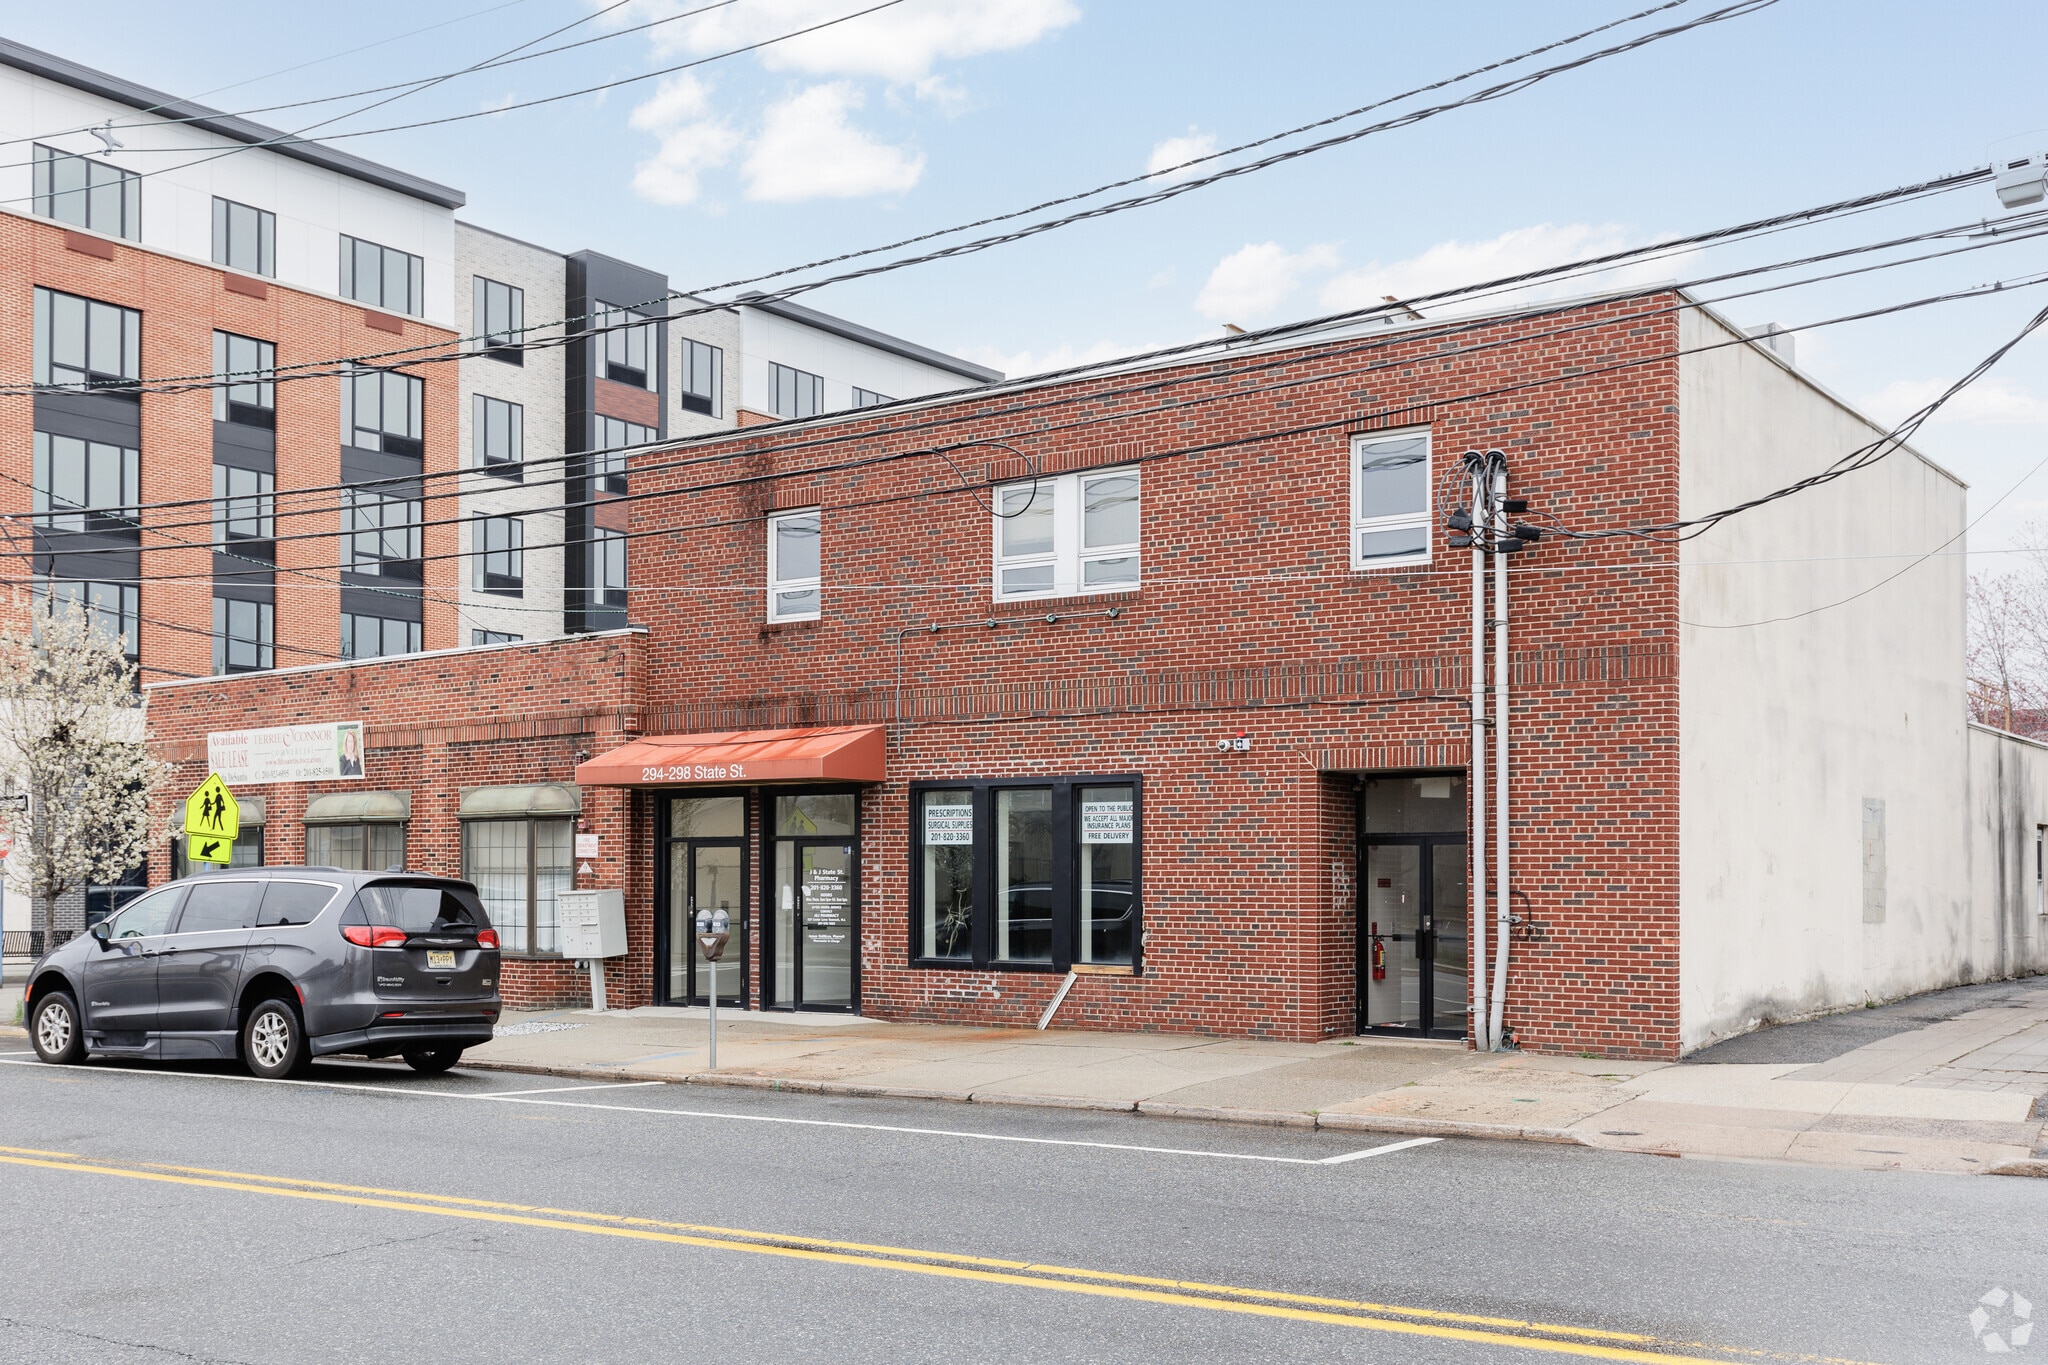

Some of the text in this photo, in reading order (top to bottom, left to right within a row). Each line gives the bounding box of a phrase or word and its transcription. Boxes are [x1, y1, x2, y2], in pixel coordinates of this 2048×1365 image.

[212, 733, 248, 746] Available
[253, 733, 282, 746] TERRIE
[642, 763, 747, 781] 294-298 State St.
[928, 808, 972, 817] PRESCRIPTIONS
[928, 820, 973, 829] SURGICAL SUPPLIES
[931, 833, 969, 841] 201-820-3360
